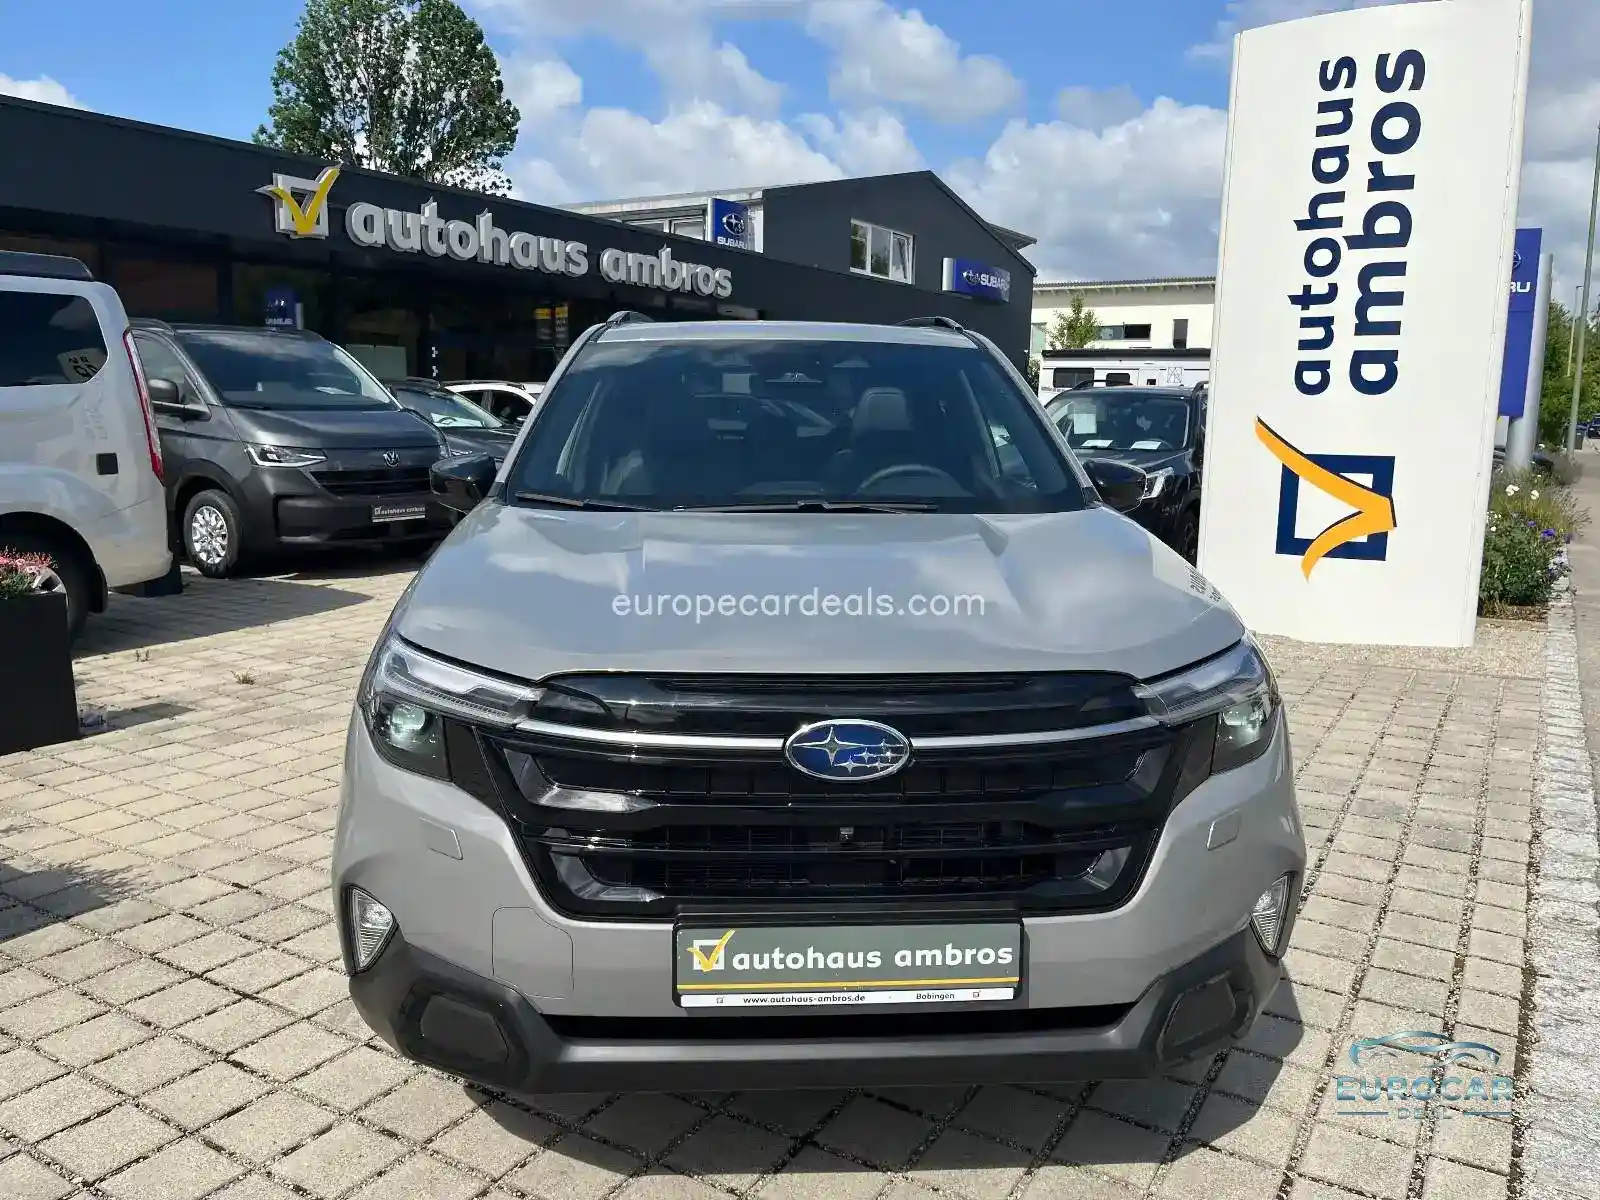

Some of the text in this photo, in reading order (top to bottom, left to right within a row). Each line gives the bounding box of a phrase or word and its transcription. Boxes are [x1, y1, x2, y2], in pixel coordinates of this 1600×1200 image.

[346, 197, 732, 298] autohaus ambros
[1287, 56, 1357, 395] autohaus
[1342, 49, 1425, 395] ambros
[732, 943, 1013, 971] autohaus ambros
[743, 992, 955, 1004] www.autohaus-ambros.de Bobingen
